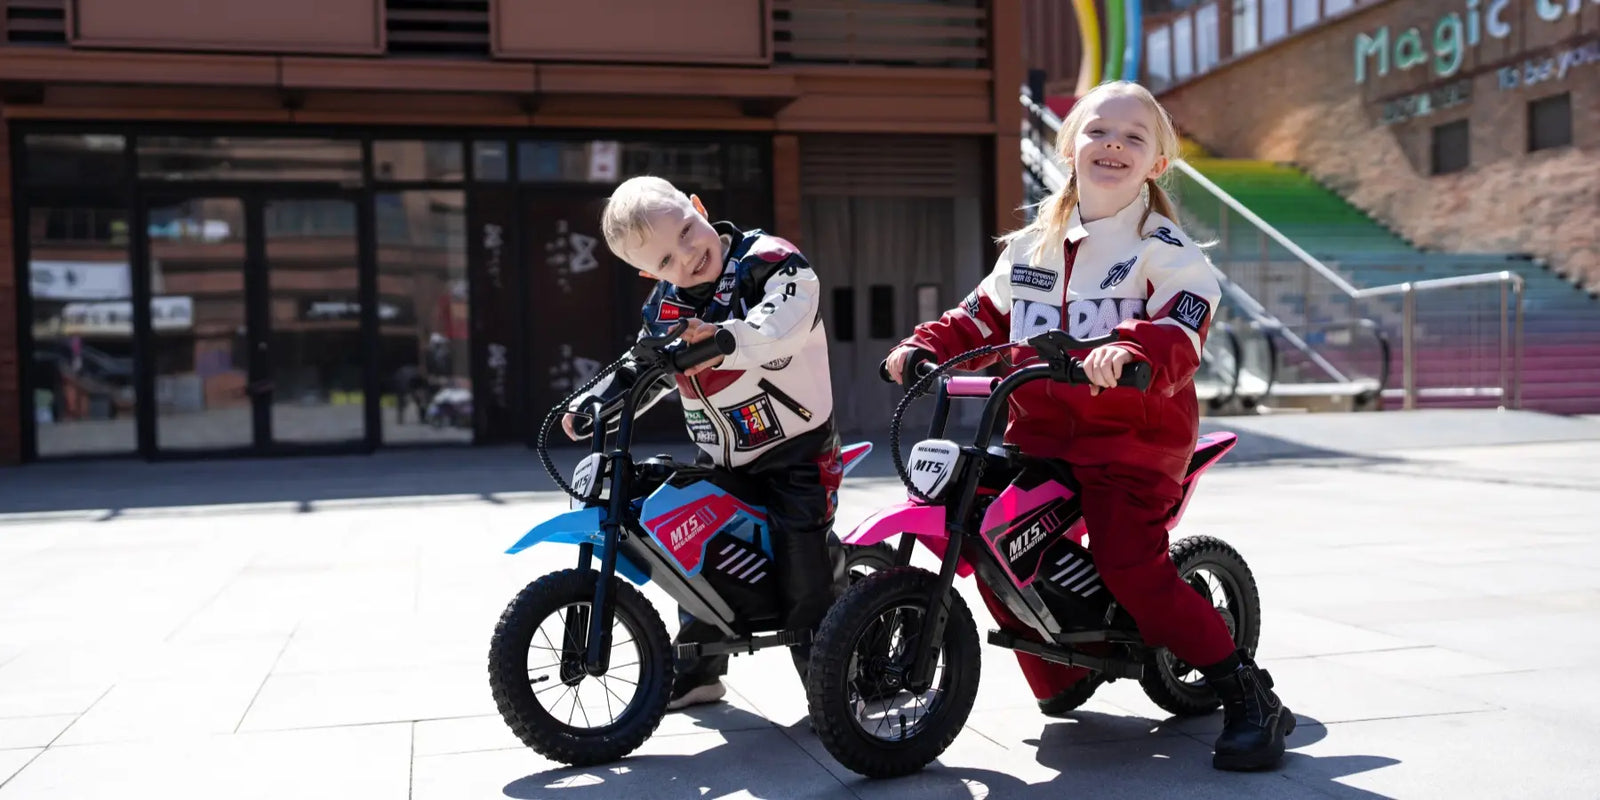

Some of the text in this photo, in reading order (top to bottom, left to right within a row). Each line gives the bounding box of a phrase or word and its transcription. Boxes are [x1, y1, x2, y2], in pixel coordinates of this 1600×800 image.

[1355, 0, 1511, 84] Magic
[1031, 277, 1053, 287] CHEAP
[740, 416, 761, 430] 72
[917, 446, 950, 455] MEGAMOTION
[673, 523, 706, 552] MEGAMOTION
[1009, 530, 1048, 564] MEGAMOTION
